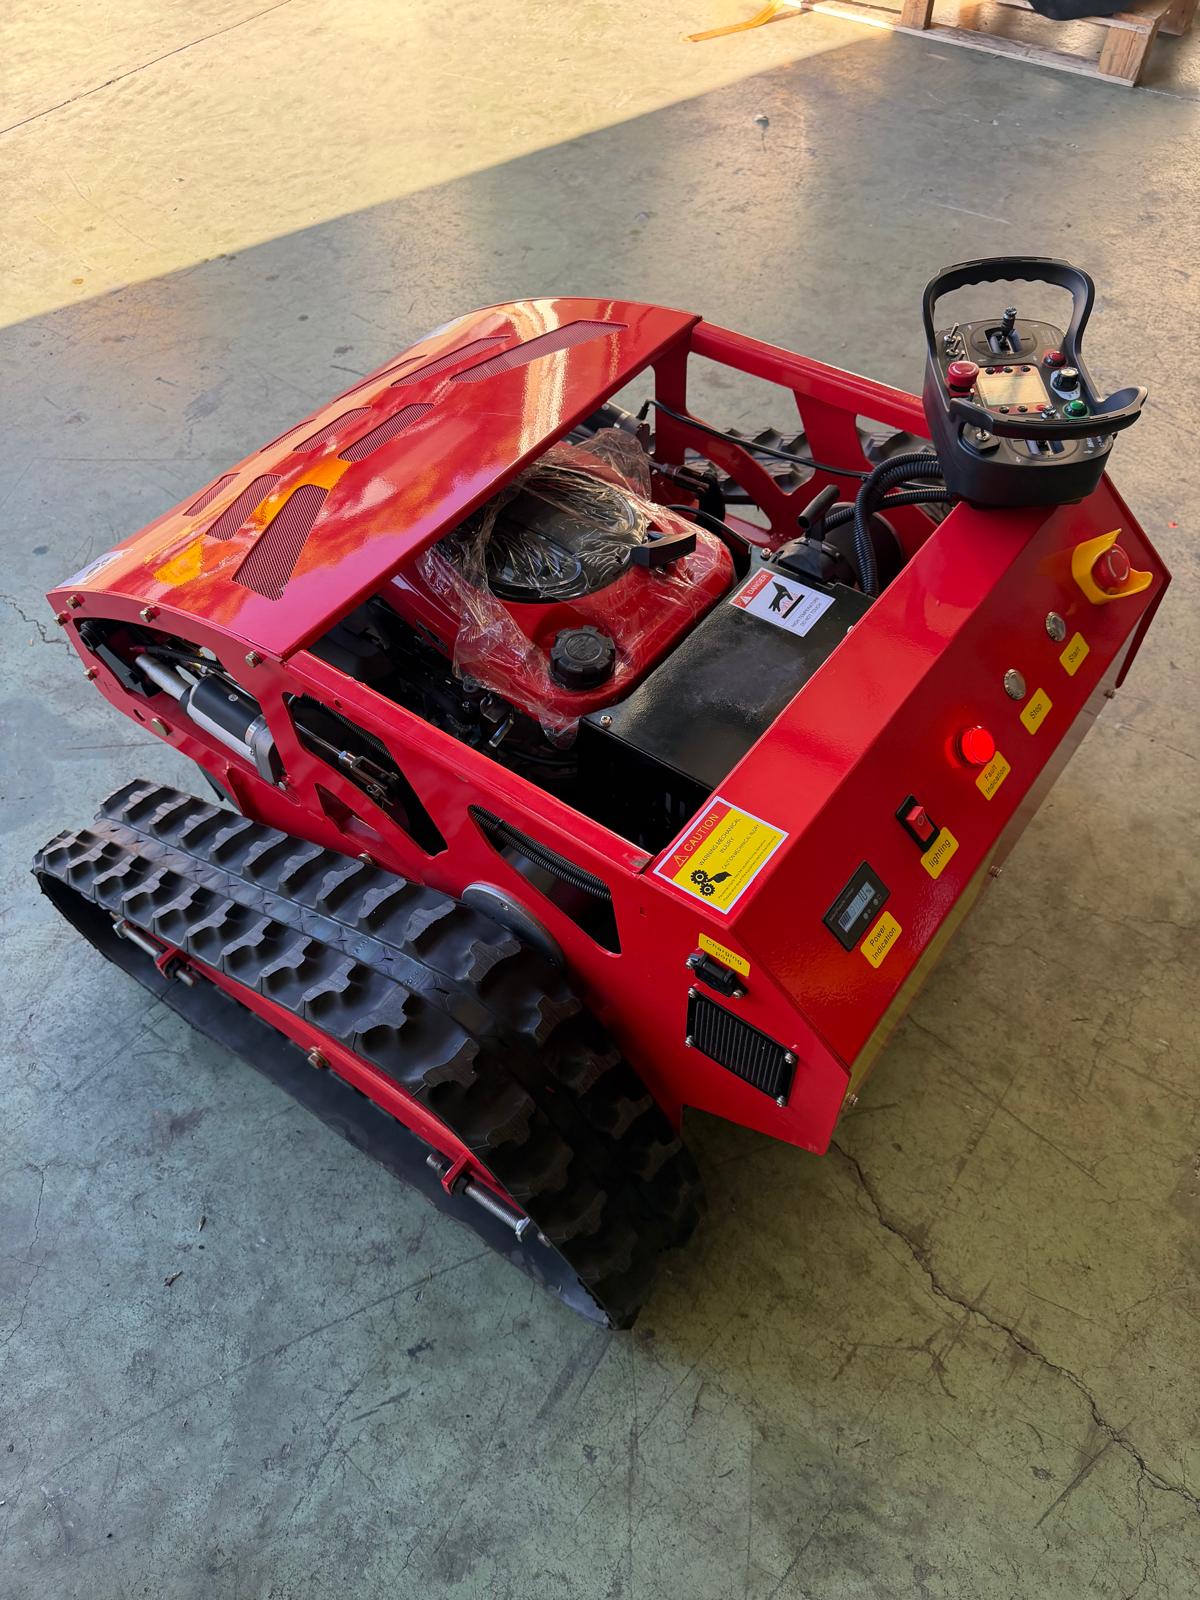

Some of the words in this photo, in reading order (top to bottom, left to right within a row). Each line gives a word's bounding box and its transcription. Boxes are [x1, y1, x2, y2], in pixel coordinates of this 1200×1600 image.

[748, 574, 769, 594] DANGER
[683, 813, 720, 853] CAUTION
[697, 843, 719, 867] WARNING
[715, 817, 742, 846] MECHANICAL
[719, 836, 735, 854] INJURY
[869, 924, 886, 947] Power
[872, 927, 897, 960] Indication
